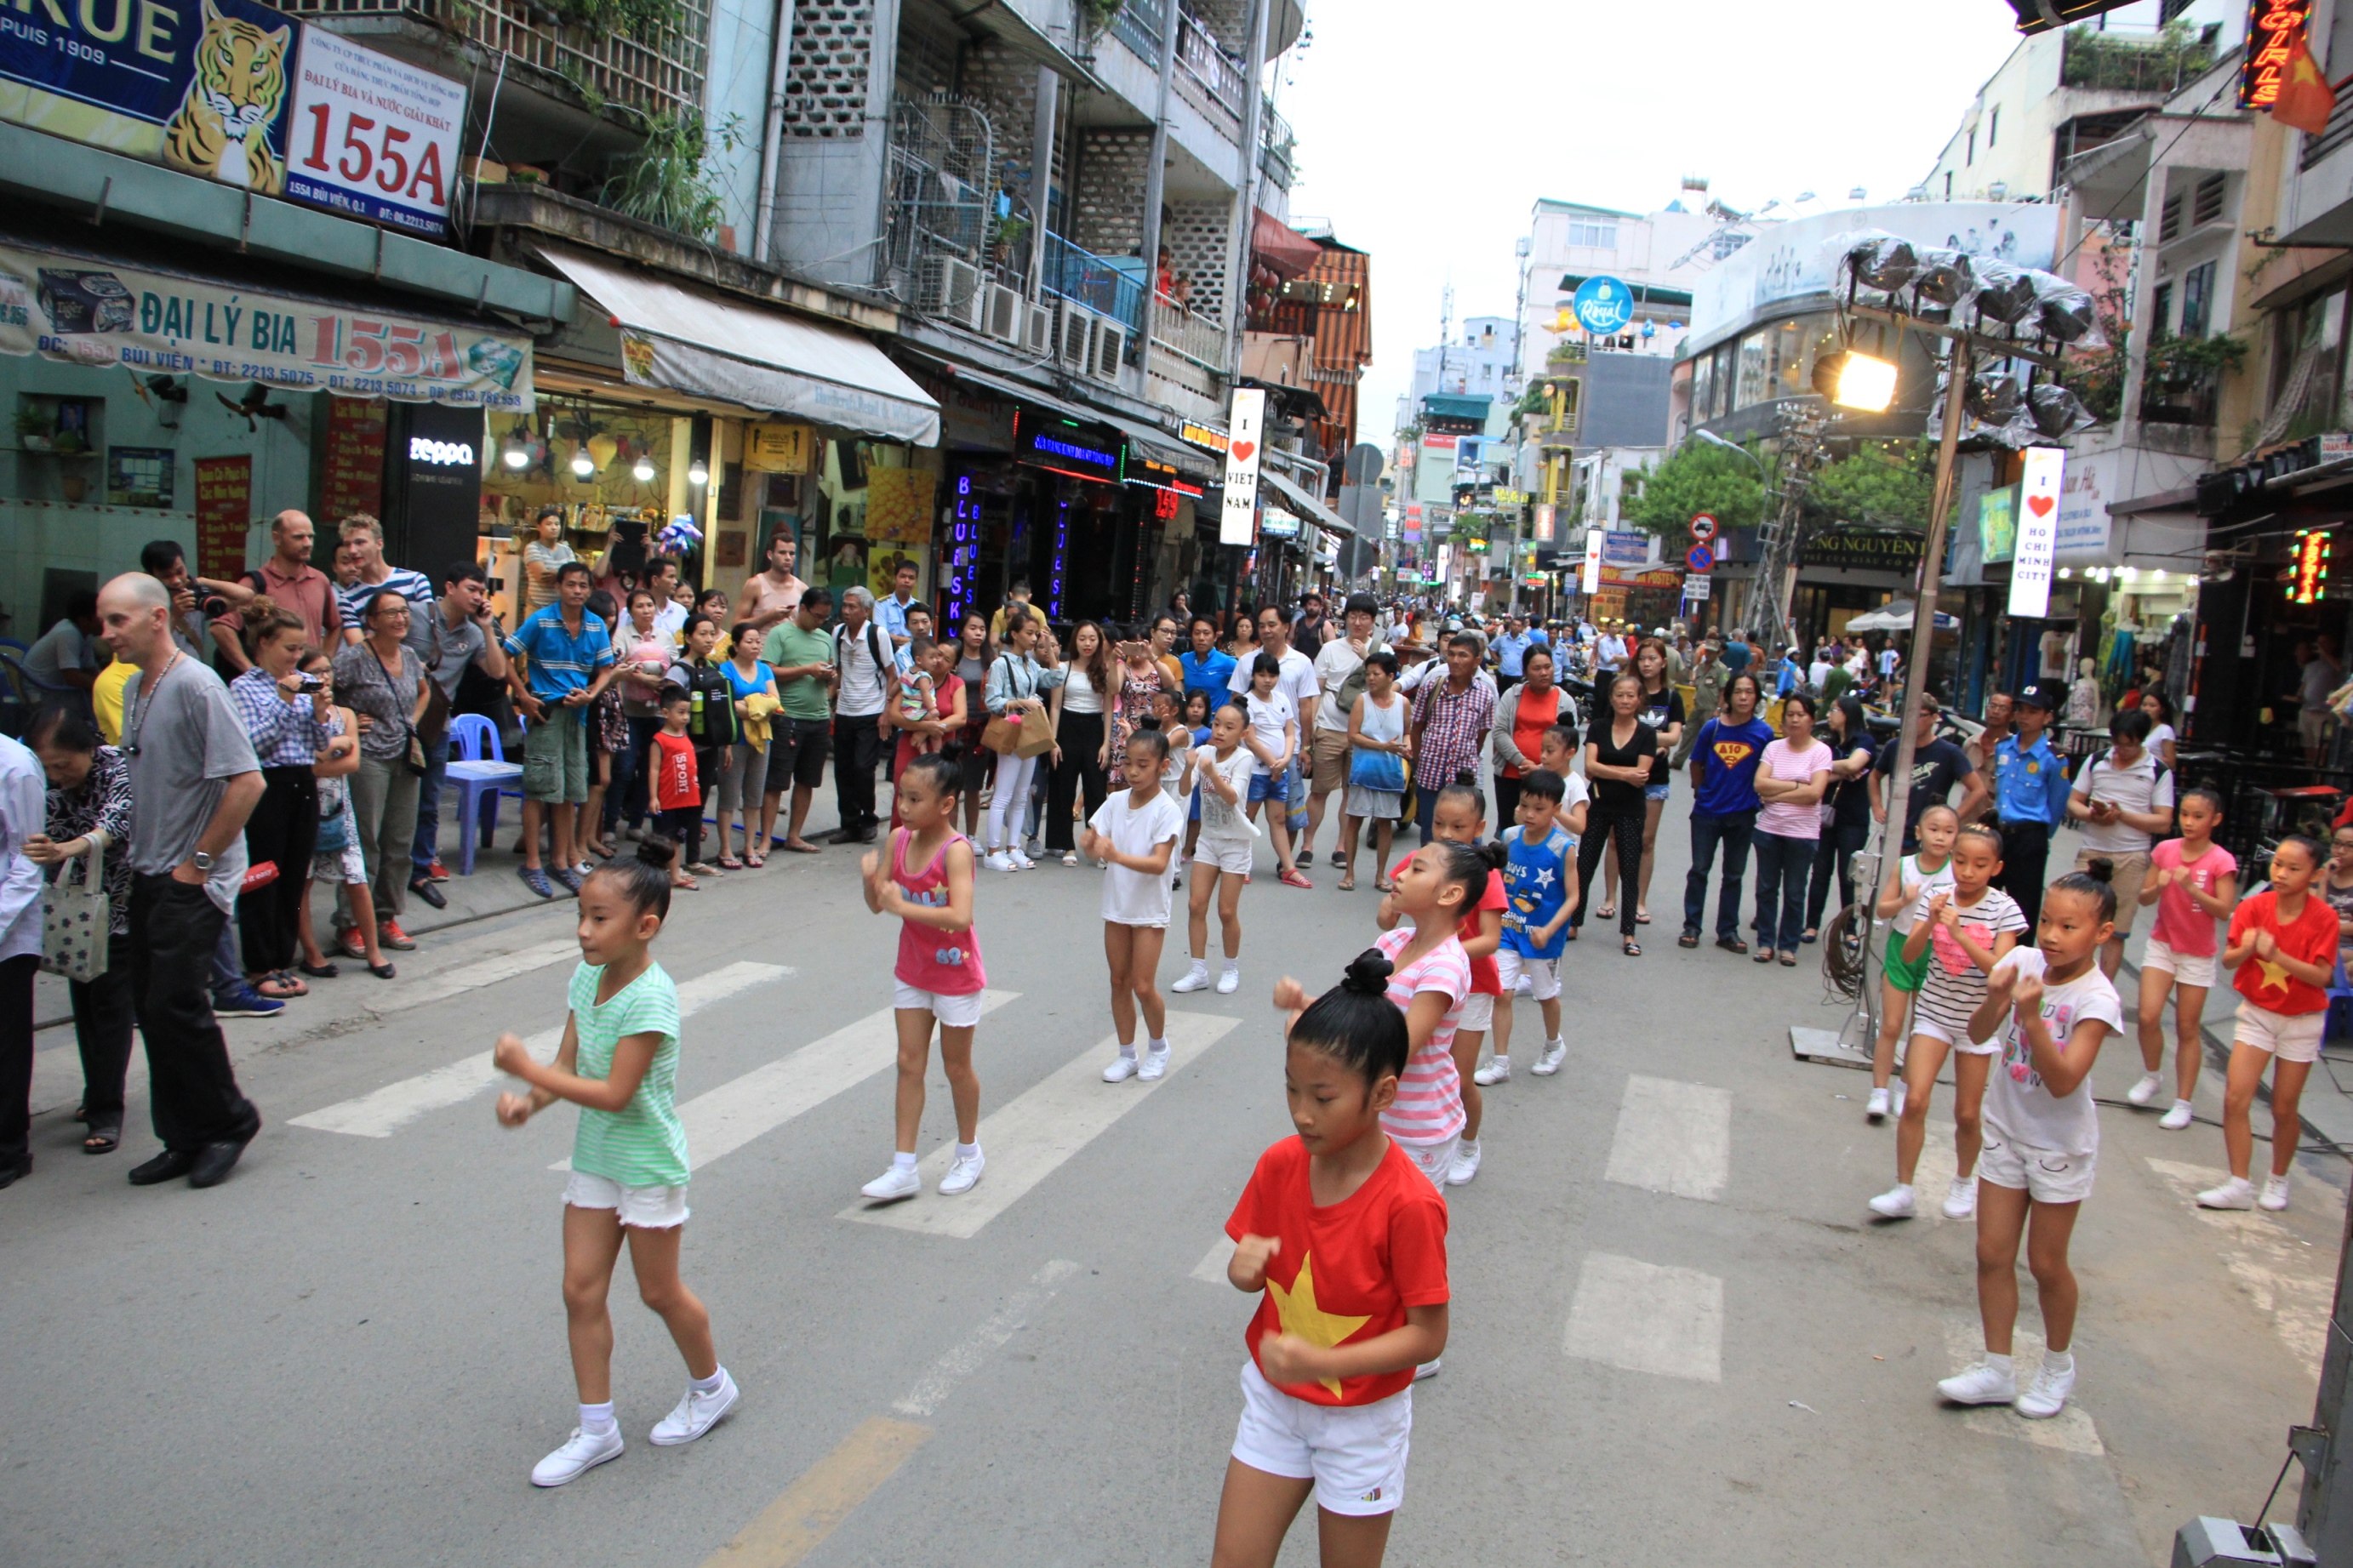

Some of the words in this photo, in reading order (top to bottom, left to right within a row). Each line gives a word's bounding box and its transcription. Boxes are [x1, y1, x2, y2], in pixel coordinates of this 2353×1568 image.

[54, 36, 106, 66] 1909
[304, 69, 324, 86] ĐẠI
[325, 76, 340, 92] LÝ
[342, 83, 359, 100] BIA
[360, 88, 374, 105] VÀ
[425, 115, 452, 132] KHÁT
[302, 102, 446, 208] 155A
[288, 180, 311, 198] 155A
[311, 186, 328, 202] BÙI
[1577, 299, 1629, 328] Royal
[140, 290, 195, 347] ĐẠI
[204, 294, 243, 347] LÝ
[251, 309, 297, 355] BIA
[306, 313, 468, 383] 155A
[38, 334, 68, 355] ĐC:
[77, 341, 117, 362] 155A
[122, 345, 150, 366] BÙI
[156, 351, 194, 372] VIỆN
[214, 359, 237, 376] ĐT:
[242, 362, 315, 385] 2213.5075
[329, 374, 349, 389] ĐT:
[353, 377, 417, 397] 2213.5074
[1242, 419, 1248, 430] I
[1228, 472, 1254, 485] VIET
[2041, 476, 2047, 486] I
[1225, 497, 1250, 509] NAM
[2029, 527, 2047, 537] HO
[1843, 535, 1915, 555] NGUYÊN
[2025, 542, 2047, 551] CHI
[2018, 556, 2050, 567] MINH
[2018, 570, 2047, 581] CITY
[676, 755, 689, 793] SPORT
